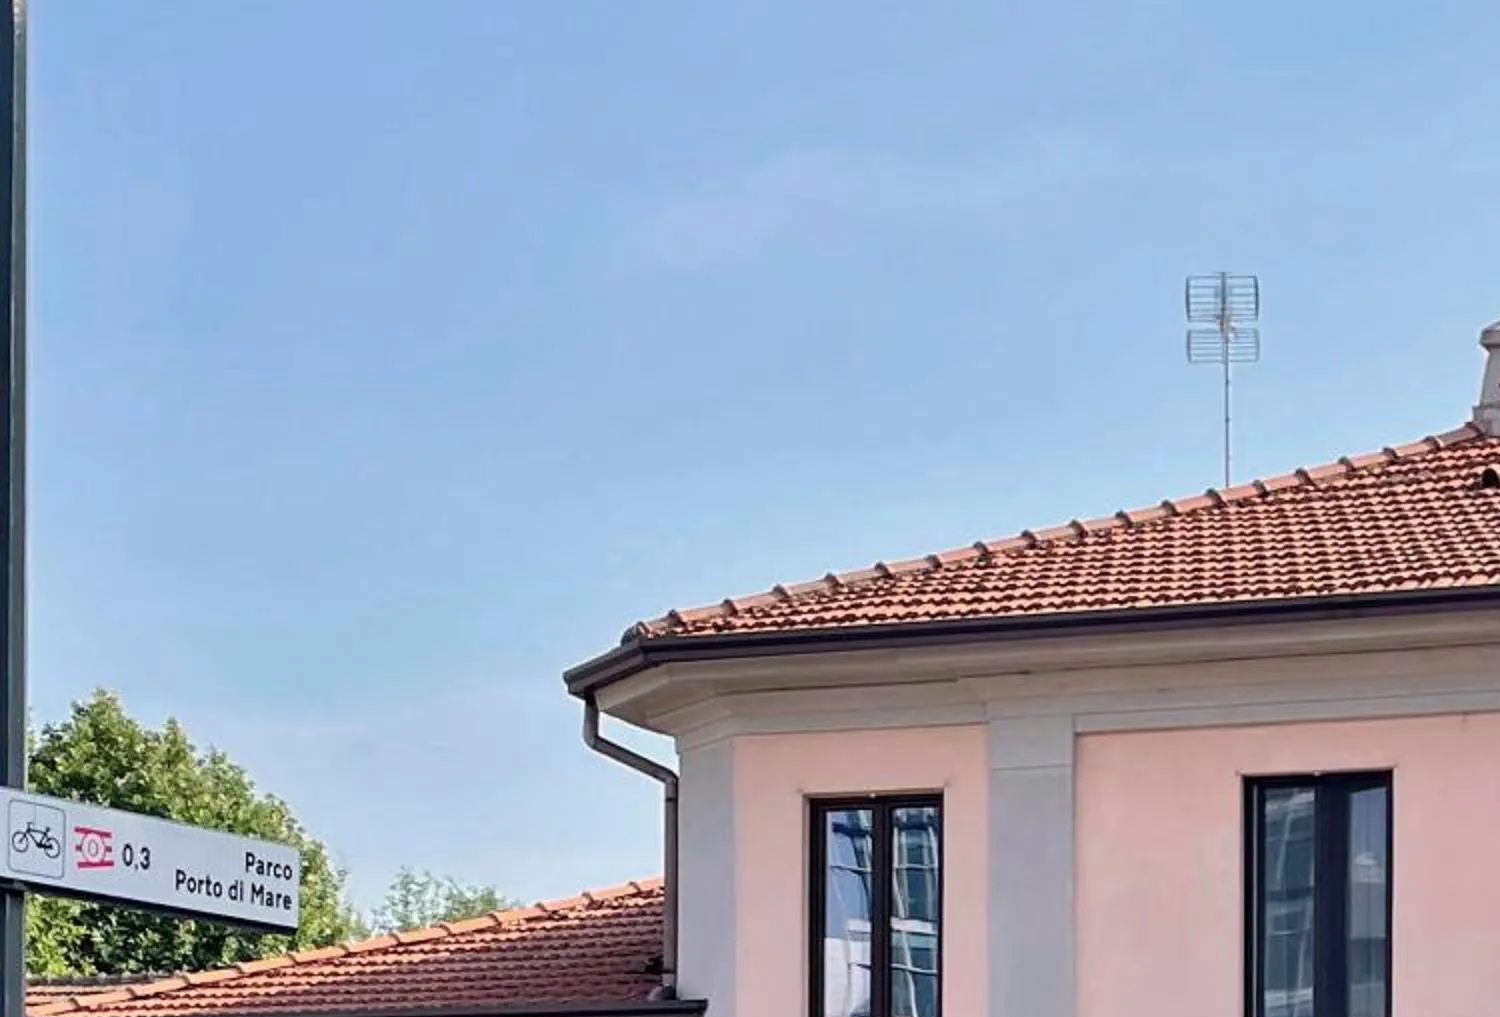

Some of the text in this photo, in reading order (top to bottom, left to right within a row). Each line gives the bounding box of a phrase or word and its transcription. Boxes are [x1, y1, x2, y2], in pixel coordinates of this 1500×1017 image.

[122, 843, 151, 870] 0,3
[245, 851, 293, 880] Parco
[175, 868, 293, 910] Porto di Mare
